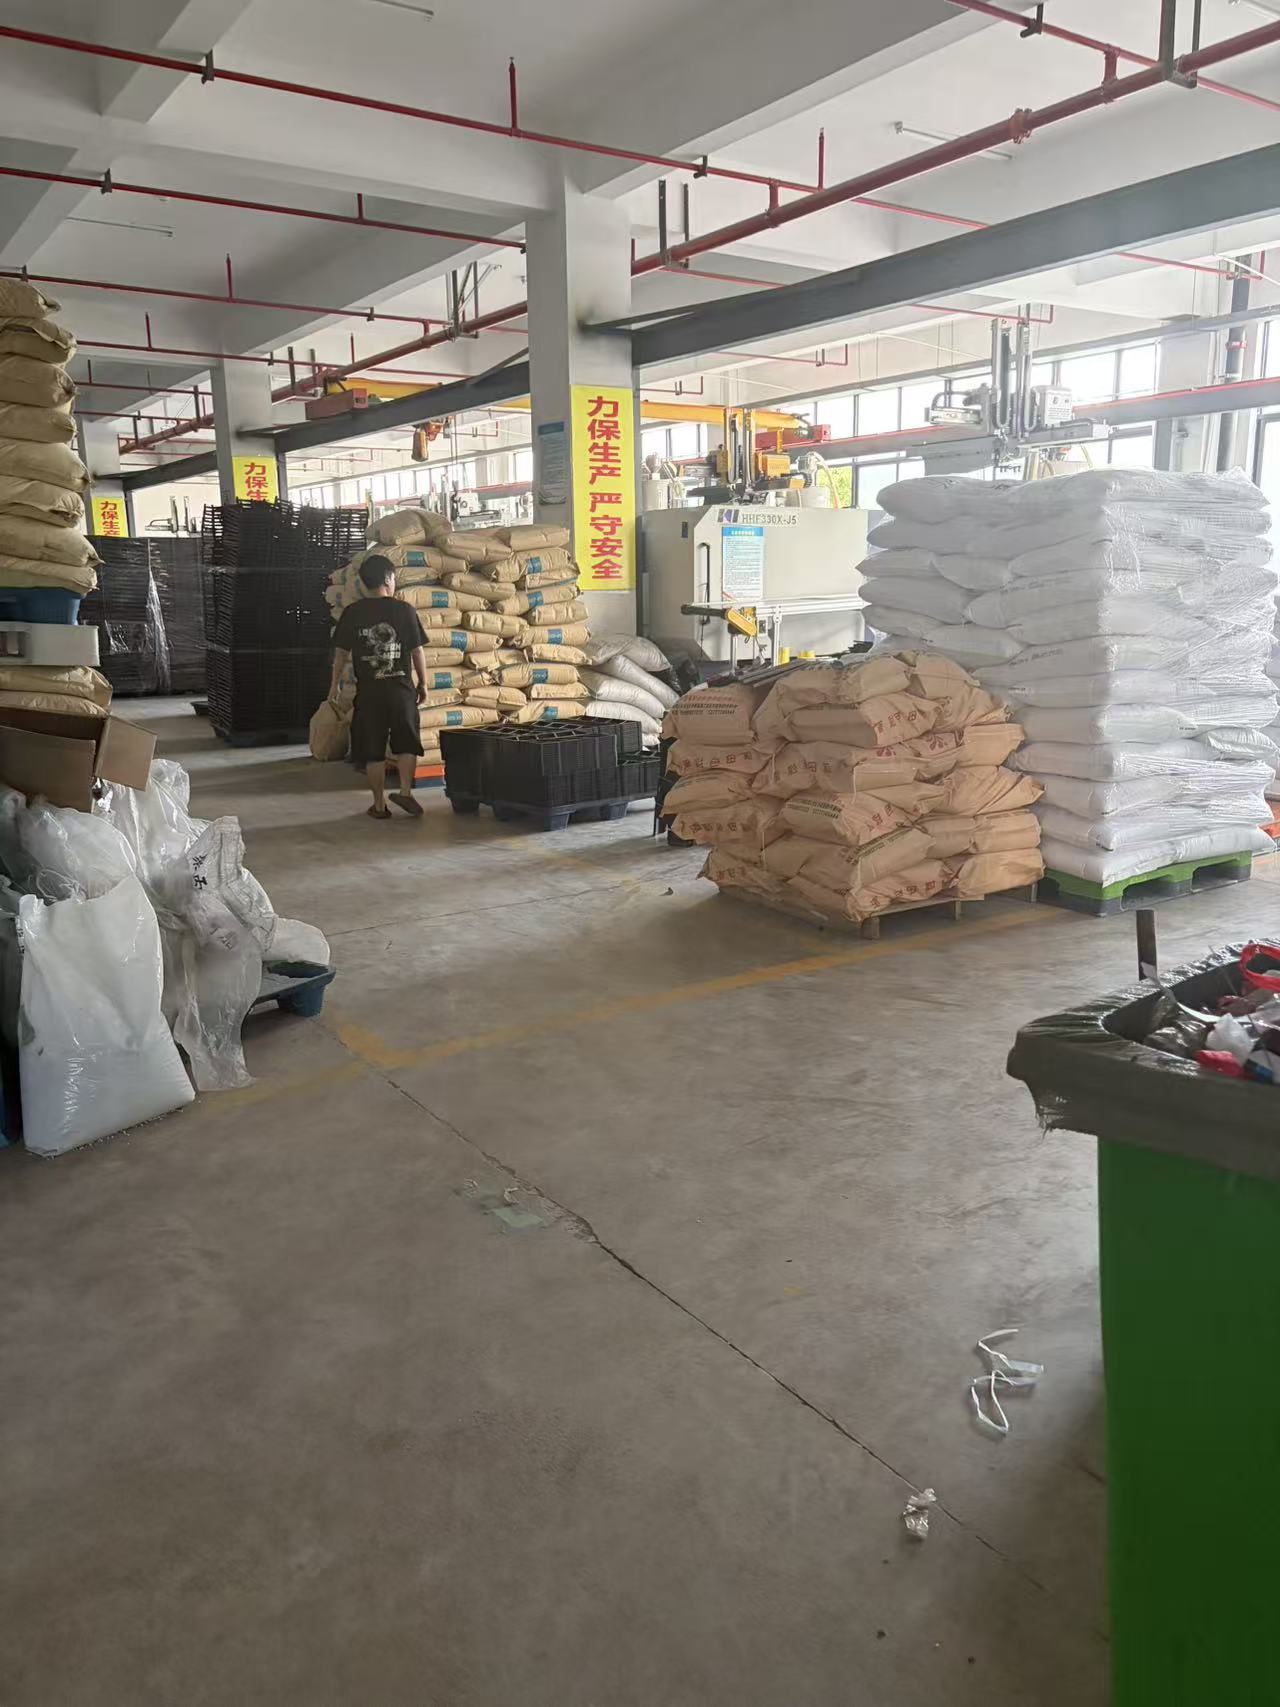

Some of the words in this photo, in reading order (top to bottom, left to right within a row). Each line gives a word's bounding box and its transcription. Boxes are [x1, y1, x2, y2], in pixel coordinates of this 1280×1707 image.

[587, 396, 621, 485] 力保生产
[589, 492, 623, 580] 严守安全
